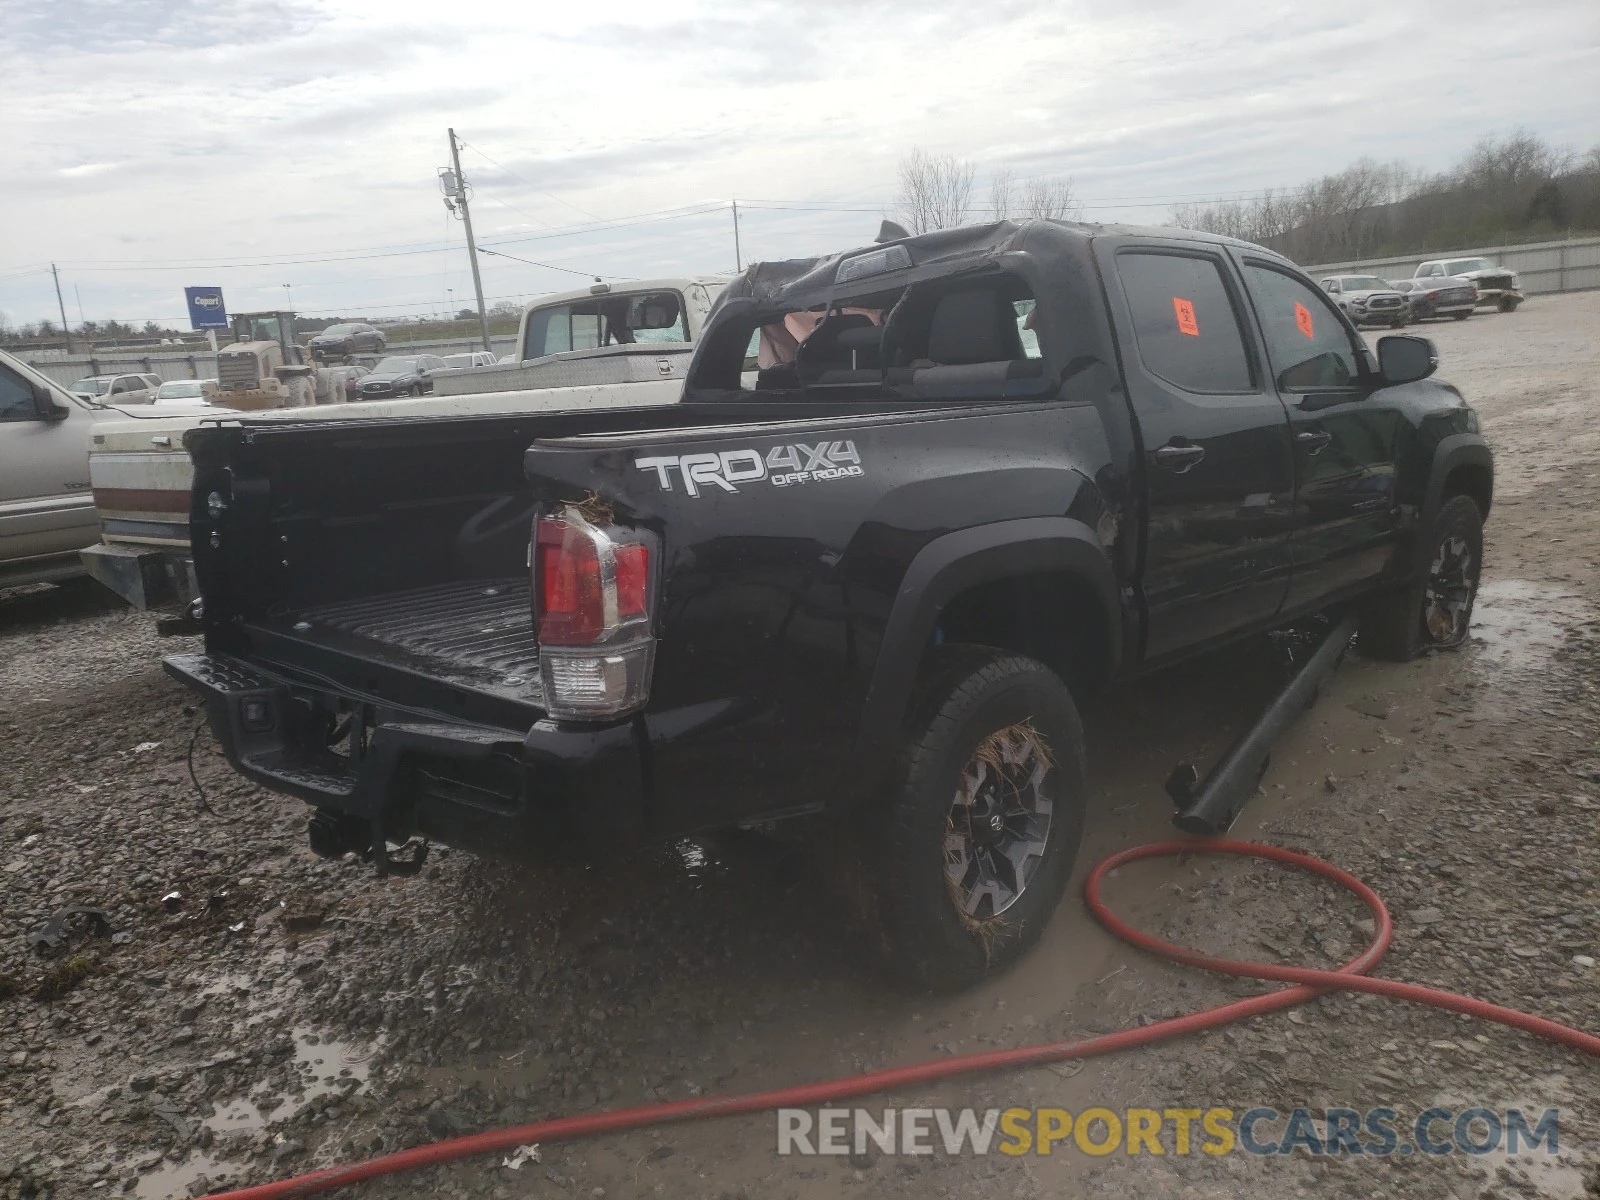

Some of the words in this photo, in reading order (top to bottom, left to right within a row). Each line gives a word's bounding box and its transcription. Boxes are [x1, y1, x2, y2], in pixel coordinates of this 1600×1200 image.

[194, 296, 219, 307] Copart
[635, 449, 768, 498] TRD
[771, 471, 813, 487] OFF
[812, 466, 864, 482] ROAD
